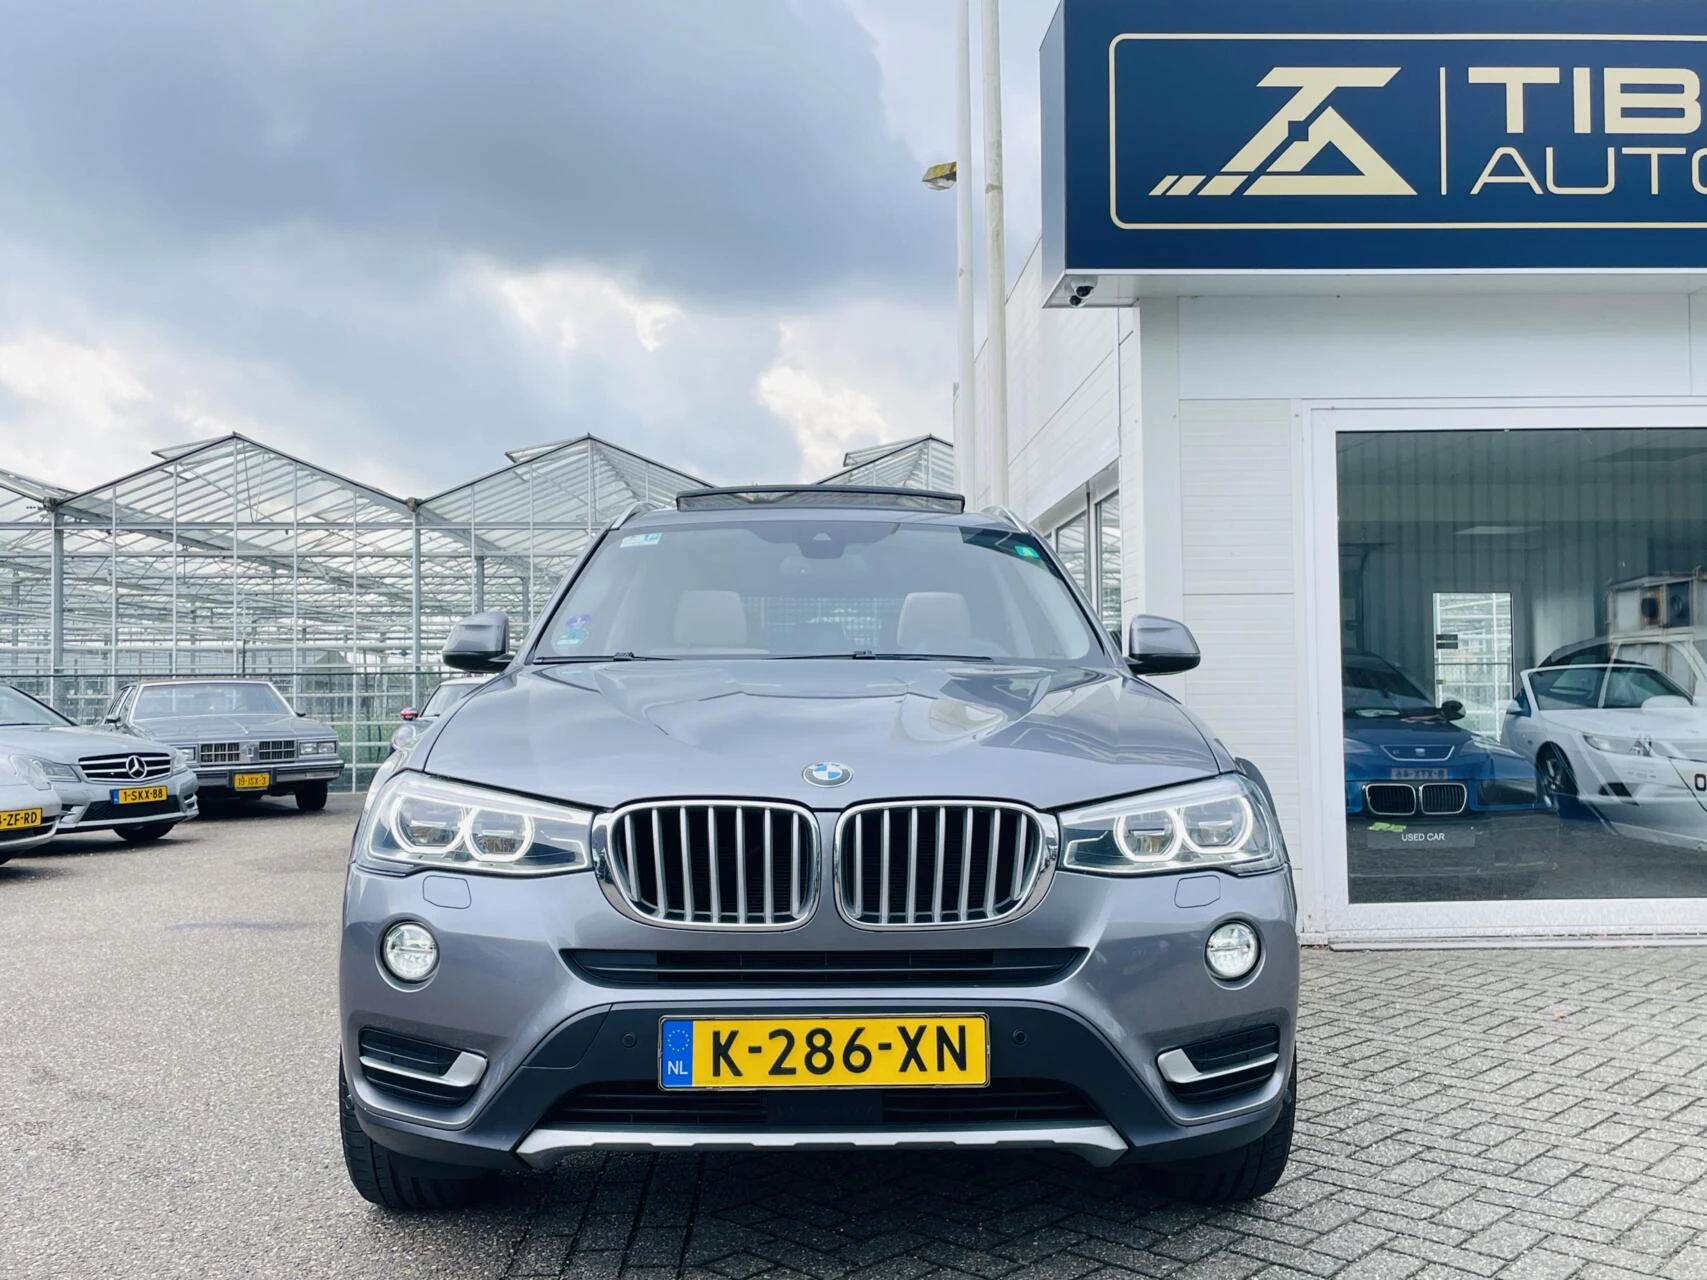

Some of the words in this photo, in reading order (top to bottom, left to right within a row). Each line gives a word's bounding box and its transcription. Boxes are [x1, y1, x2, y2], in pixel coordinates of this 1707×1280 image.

[1468, 67, 1702, 134] TIB
[1470, 147, 1707, 195] AUT
[123, 788, 163, 802] 1-SKX-88
[0, 811, 38, 827] -ZF-RD
[1401, 833, 1425, 842] USED
[1426, 832, 1446, 841] CAR
[711, 1024, 968, 1077] K-286-XN
[667, 1060, 689, 1075] NL
